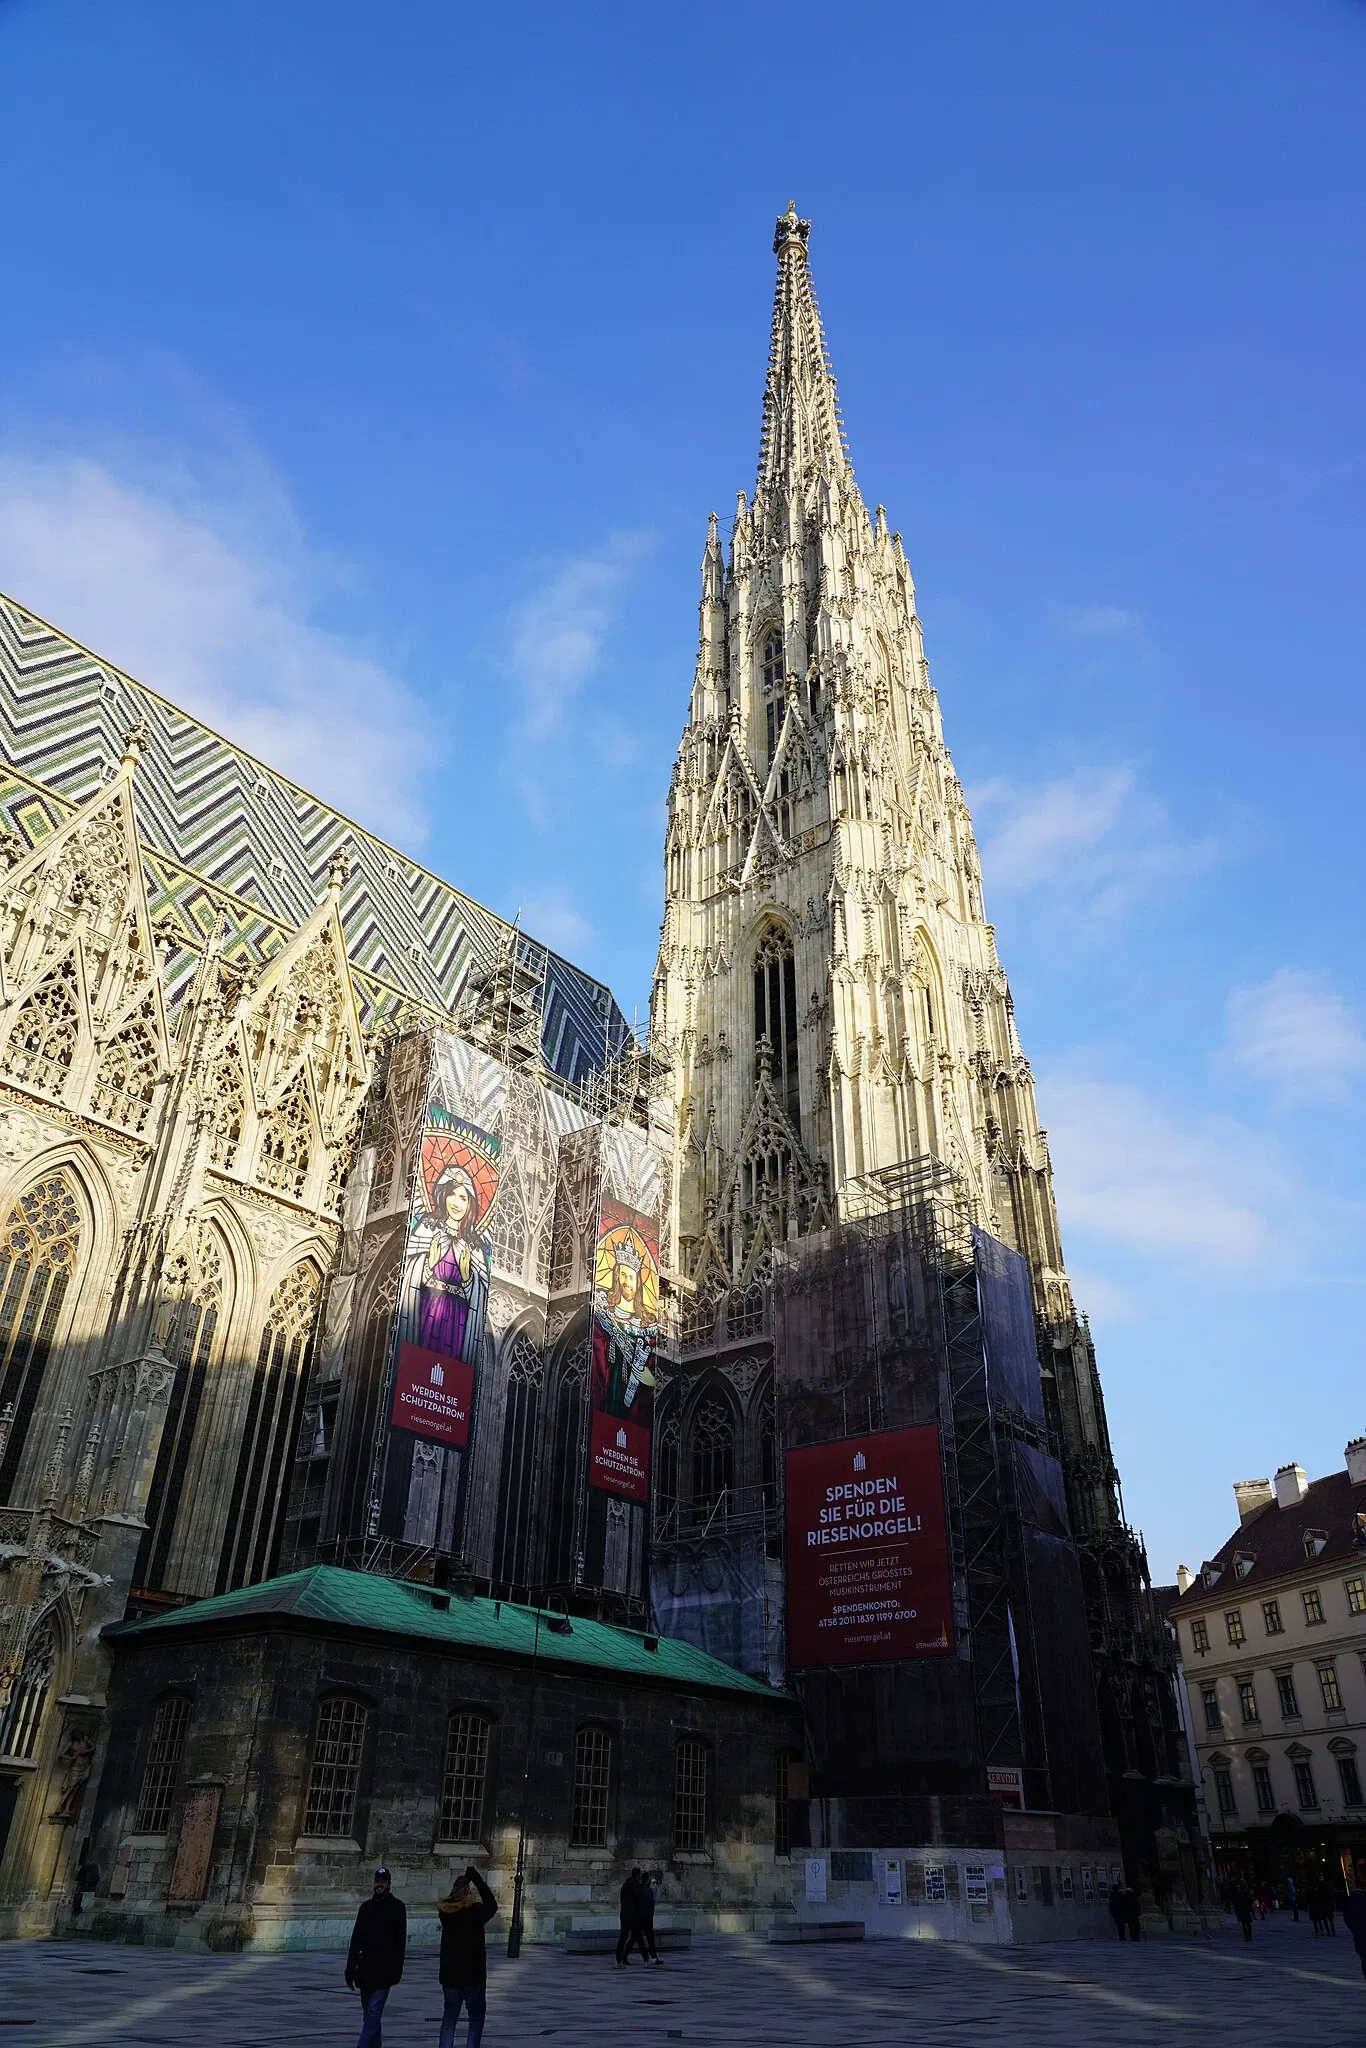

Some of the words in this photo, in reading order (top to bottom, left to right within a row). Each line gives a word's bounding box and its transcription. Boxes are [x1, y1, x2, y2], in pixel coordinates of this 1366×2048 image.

[411, 1384, 445, 1402] WERDEN
[446, 1396, 458, 1407] SIE
[400, 1392, 465, 1420] SCHUTZPATRON!
[410, 1414, 452, 1432] riesenorgel.at
[602, 1447, 629, 1462] WERDEN
[629, 1456, 638, 1466] SIE
[595, 1456, 645, 1478] SCHUTZPATRON!
[603, 1474, 635, 1490] riesenorgel.at
[826, 1476, 898, 1503] SPENDEN
[819, 1507, 841, 1524] SIE
[846, 1498, 875, 1520] FÜR
[880, 1496, 906, 1514] DIE
[807, 1515, 922, 1546] RIESENORGEL!
[829, 1563, 858, 1573] RETTEN
[859, 1560, 875, 1569] WIR
[877, 1556, 899, 1567] JETZT
[818, 1572, 870, 1586] ÖSTERREICHS
[872, 1566, 913, 1581] GRÖSSTES
[829, 1580, 902, 1597] MUSIKINSTRUMENT
[832, 1600, 901, 1614] SPENDENKONTO:
[818, 1617, 838, 1628] AT58
[839, 1615, 856, 1625] 2011
[857, 1613, 875, 1624] 1839
[876, 1612, 893, 1622] 1199
[894, 1610, 917, 1620] 6700
[844, 1632, 891, 1644] riesenorgel.at
